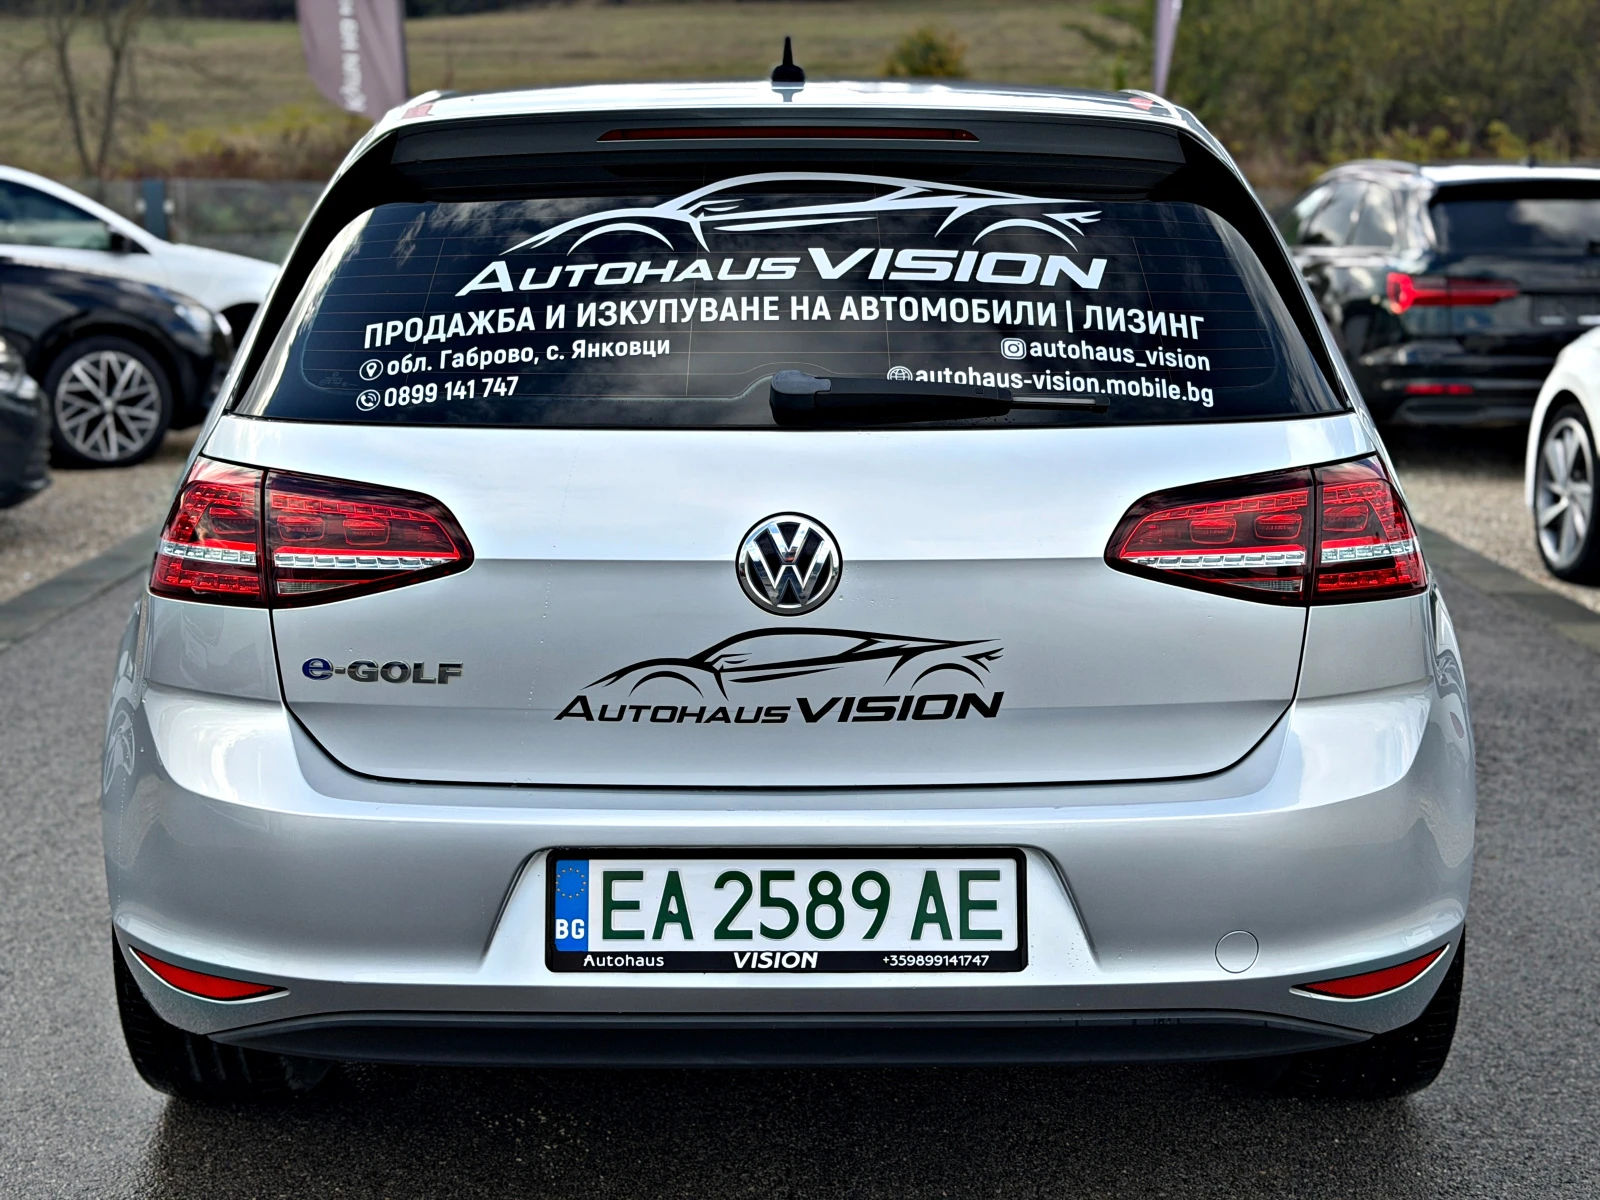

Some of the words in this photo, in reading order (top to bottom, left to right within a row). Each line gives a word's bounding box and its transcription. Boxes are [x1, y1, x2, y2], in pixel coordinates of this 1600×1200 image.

[455, 257, 801, 297] AUTOHAUS
[807, 247, 1108, 290] VISION
[364, 306, 536, 349] ПРОДАЖБА
[546, 305, 565, 329] И
[578, 297, 779, 327] ИЗКУПУВАНЕ
[791, 296, 831, 320] НА
[840, 296, 1056, 326] АВТОМОБИЛИ
[1082, 305, 1205, 340] ЛИЗИНГ
[388, 354, 431, 375] обл.
[439, 346, 539, 370] Габрово,
[547, 346, 564, 360] с.
[572, 340, 669, 358] Янковци
[1029, 339, 1211, 372] autohaus_vision
[385, 383, 437, 406] 0899
[445, 380, 474, 400] 141
[482, 376, 518, 397] 747
[915, 366, 1214, 408] autohaus-vision.mobile.bg
[301, 655, 463, 684] e-GOLF
[554, 694, 791, 724] AUTOHAUS
[796, 692, 1004, 723] VISION
[603, 871, 693, 939] EA
[714, 870, 890, 939] 2589
[911, 870, 1002, 940] AE
[556, 919, 584, 939] BG
[584, 955, 664, 966] Autohaus
[734, 952, 818, 968] VISION
[883, 955, 989, 966] +359899141747
